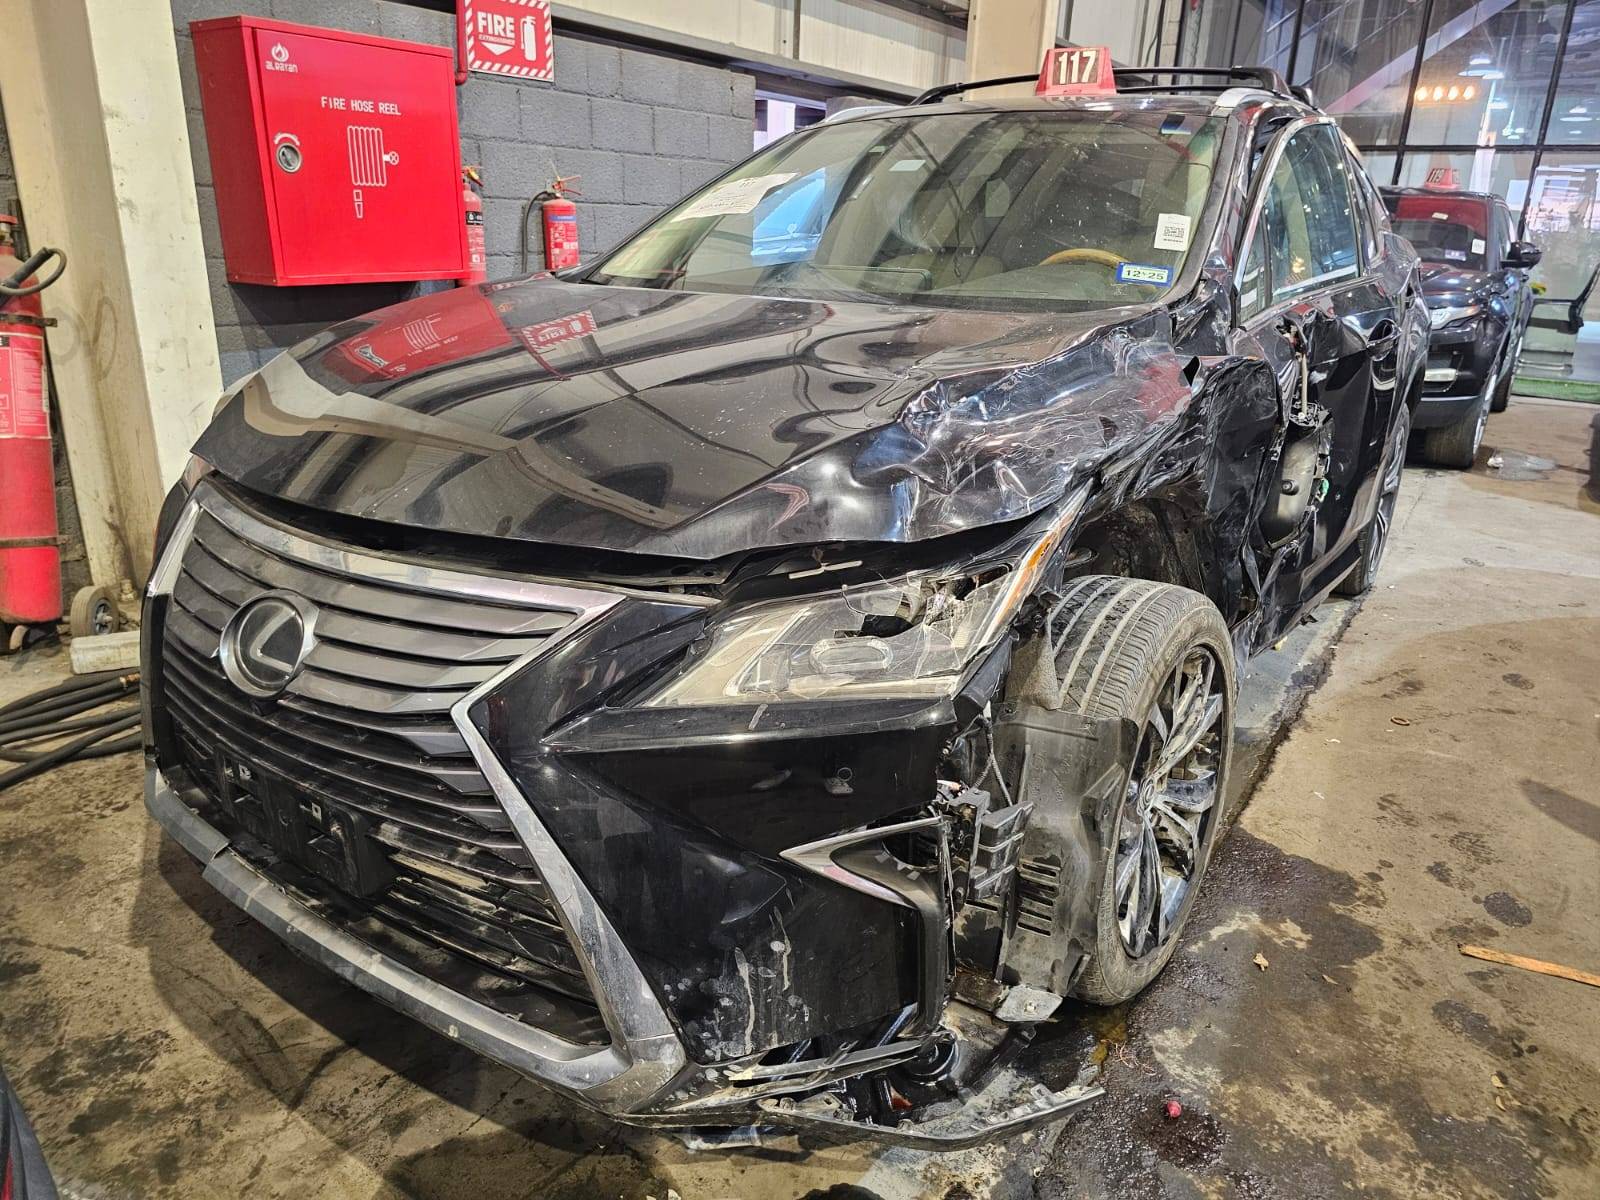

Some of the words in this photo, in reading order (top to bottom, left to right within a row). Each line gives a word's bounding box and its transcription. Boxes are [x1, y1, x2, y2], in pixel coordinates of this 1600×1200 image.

[477, 11, 515, 38] FIRE
[1058, 50, 1096, 85] 117
[321, 96, 346, 110] FIRE
[351, 99, 375, 113] HOSE
[378, 102, 402, 115] REEL
